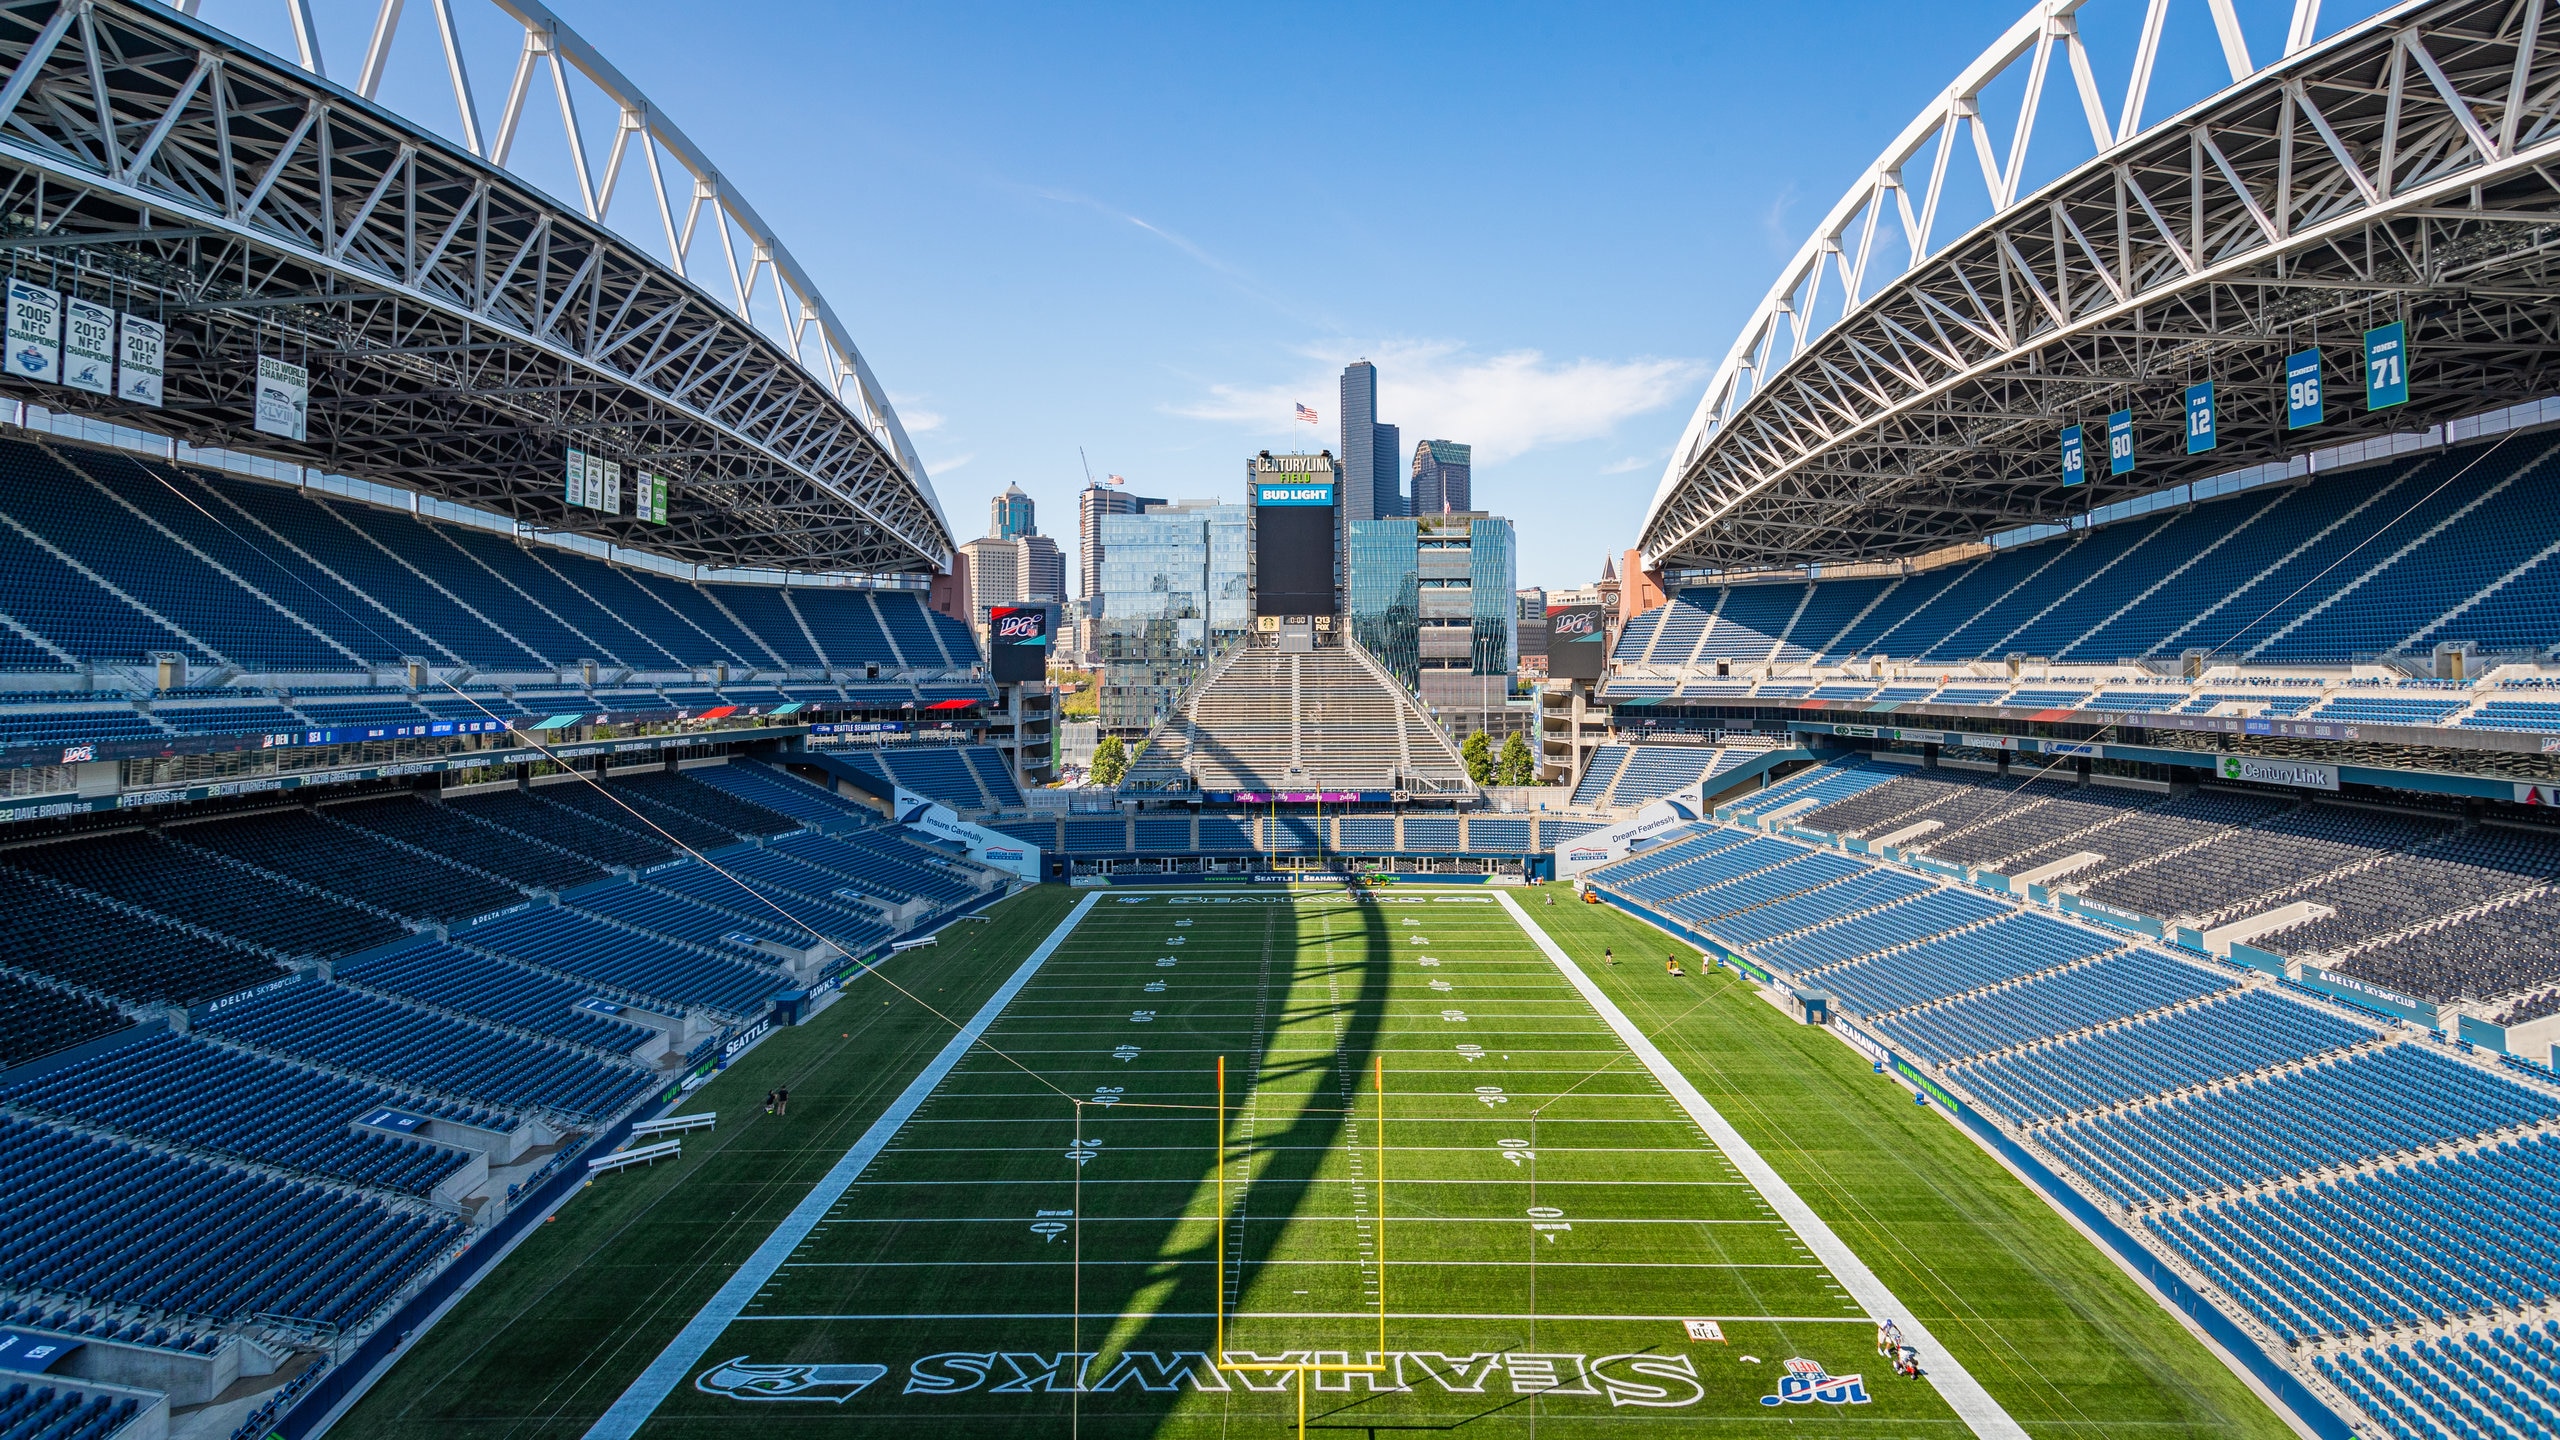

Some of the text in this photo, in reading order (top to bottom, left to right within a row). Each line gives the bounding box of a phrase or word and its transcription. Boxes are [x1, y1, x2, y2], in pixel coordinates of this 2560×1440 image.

[17, 303, 50, 324] 2005
[21, 320, 46, 335] NFC
[74, 321, 106, 340] 2013
[8, 328, 58, 349] CHAMPIONS
[78, 336, 101, 351] NFC
[128, 337, 157, 355] 2014
[67, 345, 112, 364] CHAMPIONS
[2372, 340, 2398, 355] JONES
[132, 351, 153, 365] NFC
[121, 360, 162, 377] CHAMPIONS
[260, 358, 306, 379] 2013 WORLD
[2371, 355, 2401, 390] 71
[260, 368, 306, 388] CHAMPIONS
[2193, 396, 2207, 406] FAN
[2290, 378, 2319, 410] 96
[258, 404, 293, 421] XLVIII
[2190, 408, 2211, 437] 12
[2112, 433, 2131, 459] 80
[1258, 457, 1333, 473] CENTURYLINK
[2063, 448, 2082, 472] 45
[1280, 472, 1311, 484] FIELD
[1263, 490, 1328, 500] BUD LIGHT
[1290, 616, 1306, 624] 0:00
[1315, 616, 1331, 625] Q13
[834, 723, 881, 733] SEATTLE SEAHAWKS
[2128, 715, 2139, 724] SEA
[2226, 721, 2238, 730] 0:00
[2295, 724, 2307, 735] KICK
[2315, 725, 2330, 736] GOOD
[275, 734, 289, 745] DEN
[309, 731, 321, 743] SEA
[2055, 744, 2093, 754] BOEING
[377, 764, 423, 777] 45 KENNY EASLEY
[447, 761, 455, 770] 17
[2244, 762, 2328, 786] CenturyLink
[300, 776, 311, 786] 79
[310, 774, 330, 785] JACOB
[330, 773, 349, 783] GREEN
[207, 786, 221, 797] 28
[220, 783, 239, 796] CURT
[239, 781, 267, 794] WARNER
[123, 793, 143, 807] PETE
[143, 791, 171, 804] GROSS
[0, 802, 93, 822] 22 DAVE BROWN 76-86
[926, 816, 984, 844] Insure Carefully
[1612, 815, 1675, 843] Dream Fearlessly
[651, 863, 666, 873] DELTA
[2085, 900, 2106, 912] DELTA
[479, 911, 500, 923] DELTA
[2329, 973, 2362, 991] DELTA
[221, 990, 254, 1008] DELTA
[726, 1019, 769, 1058] SEATTLE
[1834, 1016, 1891, 1063] SEAHAWKS
[1091, 1086, 1124, 1103] 30
[1474, 1086, 1508, 1103] 30
[1064, 1138, 1103, 1159] 20
[1497, 1138, 1536, 1160] 20
[1030, 1209, 1074, 1233] 10
[1526, 1206, 1572, 1231] 10
[1691, 1327, 1720, 1340] NFL
[1789, 1361, 1820, 1373] NFL
[903, 1350, 1705, 1408] SEAHAWKS
[1777, 1373, 1872, 1405] 100
